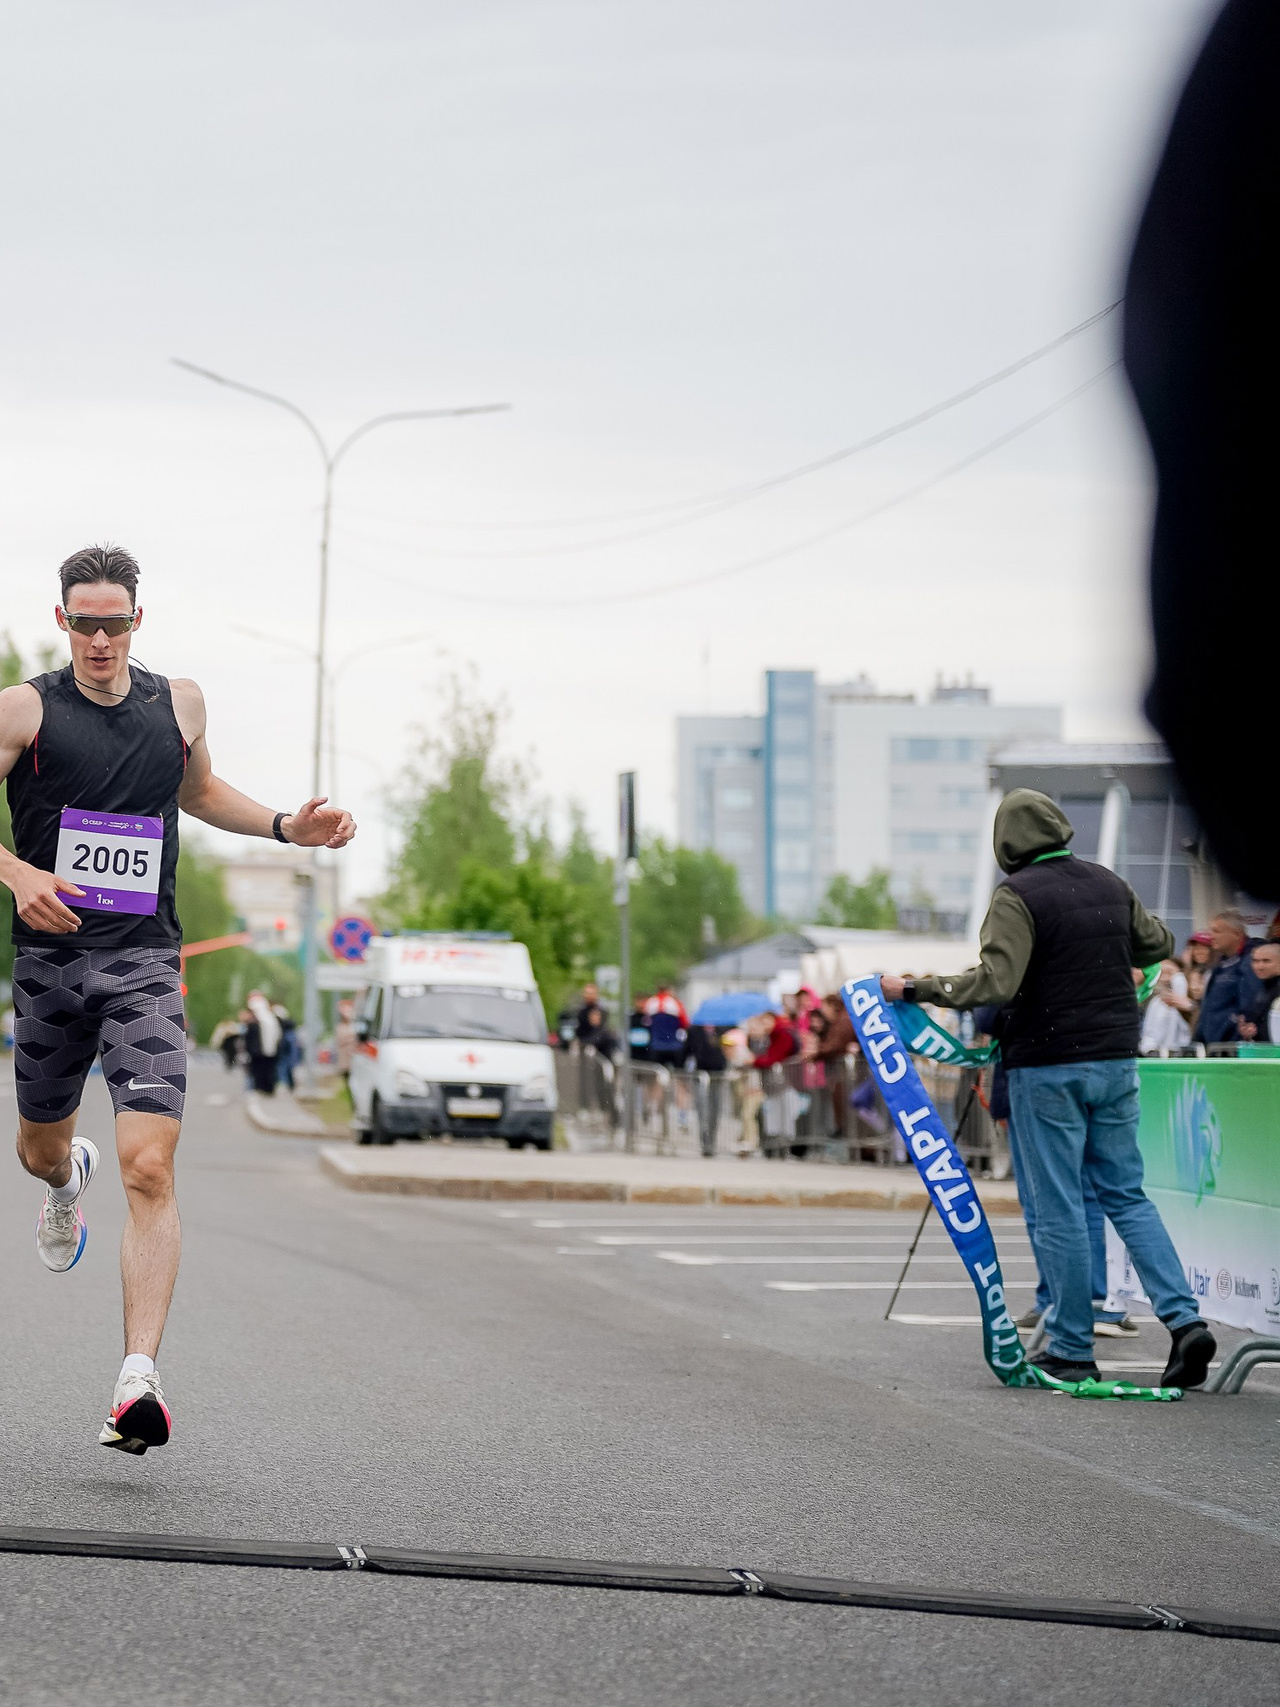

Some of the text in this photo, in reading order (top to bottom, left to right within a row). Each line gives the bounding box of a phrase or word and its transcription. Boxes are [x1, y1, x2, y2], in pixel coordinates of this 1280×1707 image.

[72, 843, 149, 878] 2005
[898, 1106, 982, 1234] СТАРТ
[974, 1260, 1024, 1371] СТАРТ
[1188, 1266, 1211, 1297] Utair
